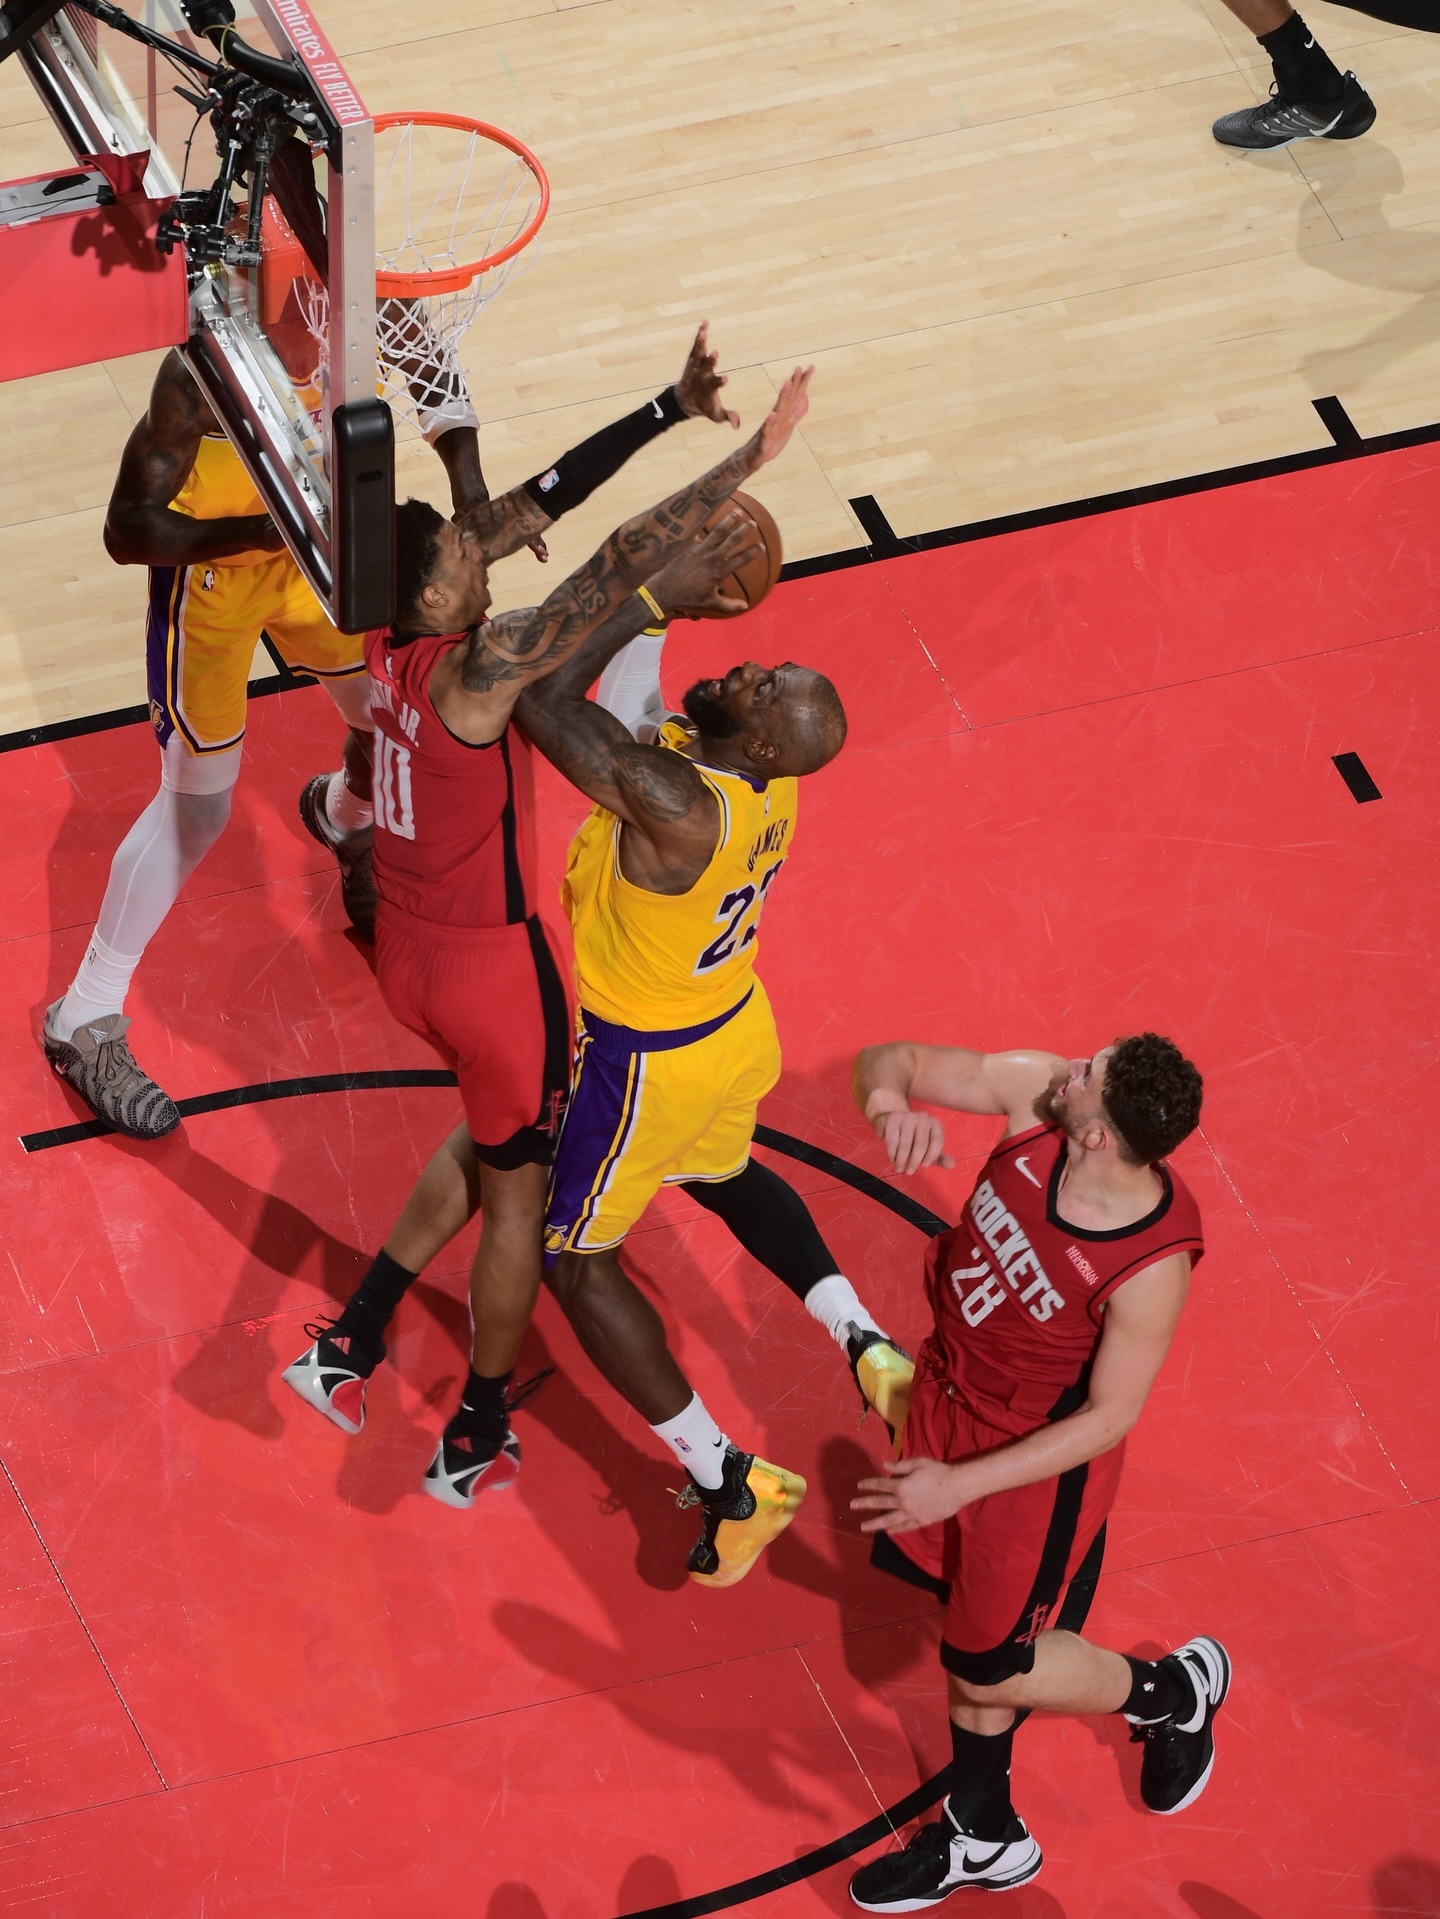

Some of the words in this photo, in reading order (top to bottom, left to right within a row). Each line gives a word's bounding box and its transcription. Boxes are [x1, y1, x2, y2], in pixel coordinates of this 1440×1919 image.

[276, 0, 325, 59] mirates
[312, 62, 344, 80] FLY
[323, 81, 365, 119] BETTER
[398, 702, 420, 748] JR.
[373, 725, 416, 841] 10
[747, 818, 789, 873] JAMES
[970, 1179, 1066, 1322] ROCKETS
[951, 1247, 1007, 1328] 28
